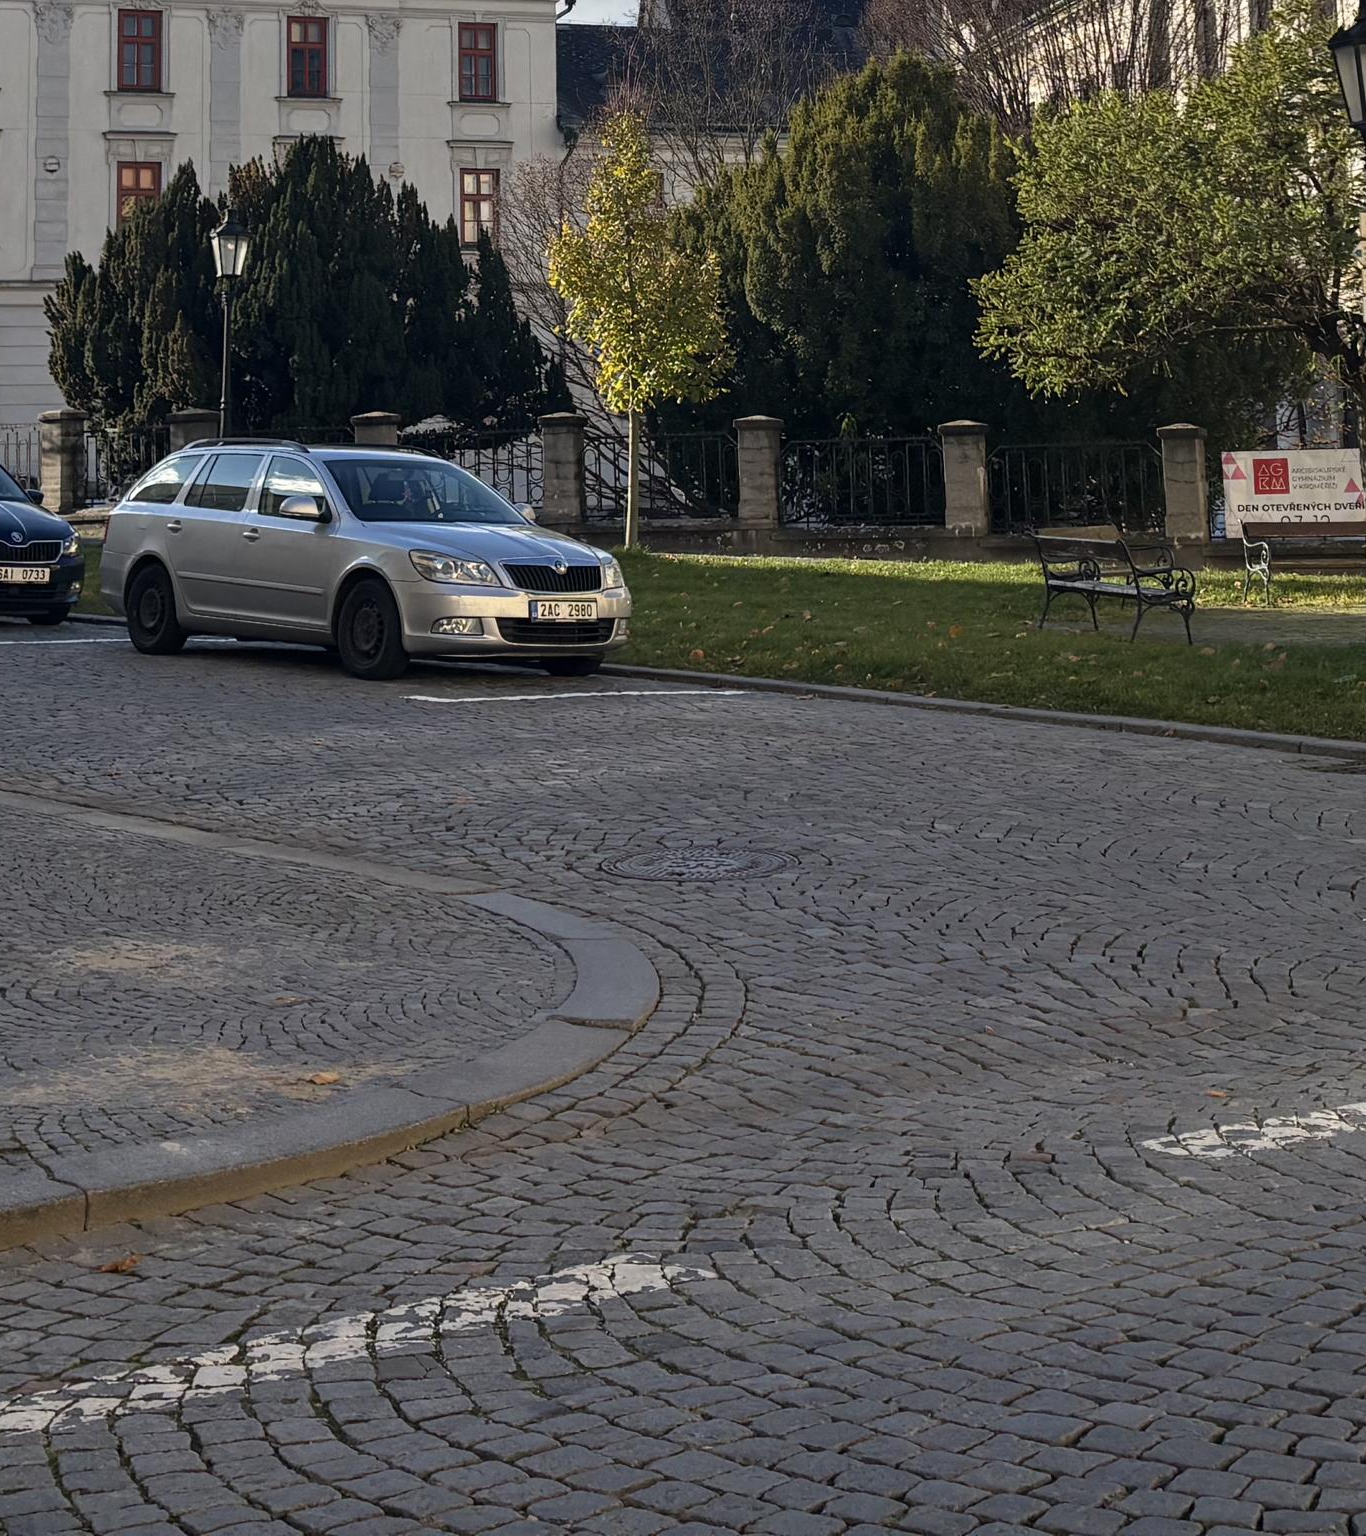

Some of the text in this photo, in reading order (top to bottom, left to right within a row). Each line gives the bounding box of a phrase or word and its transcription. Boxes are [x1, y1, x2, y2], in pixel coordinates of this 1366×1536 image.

[1237, 504, 1259, 512] DEN
[1261, 501, 1332, 512] OTEVŘENÝCH
[22, 569, 46, 580] 0733
[540, 603, 593, 617] 2AC 2980
